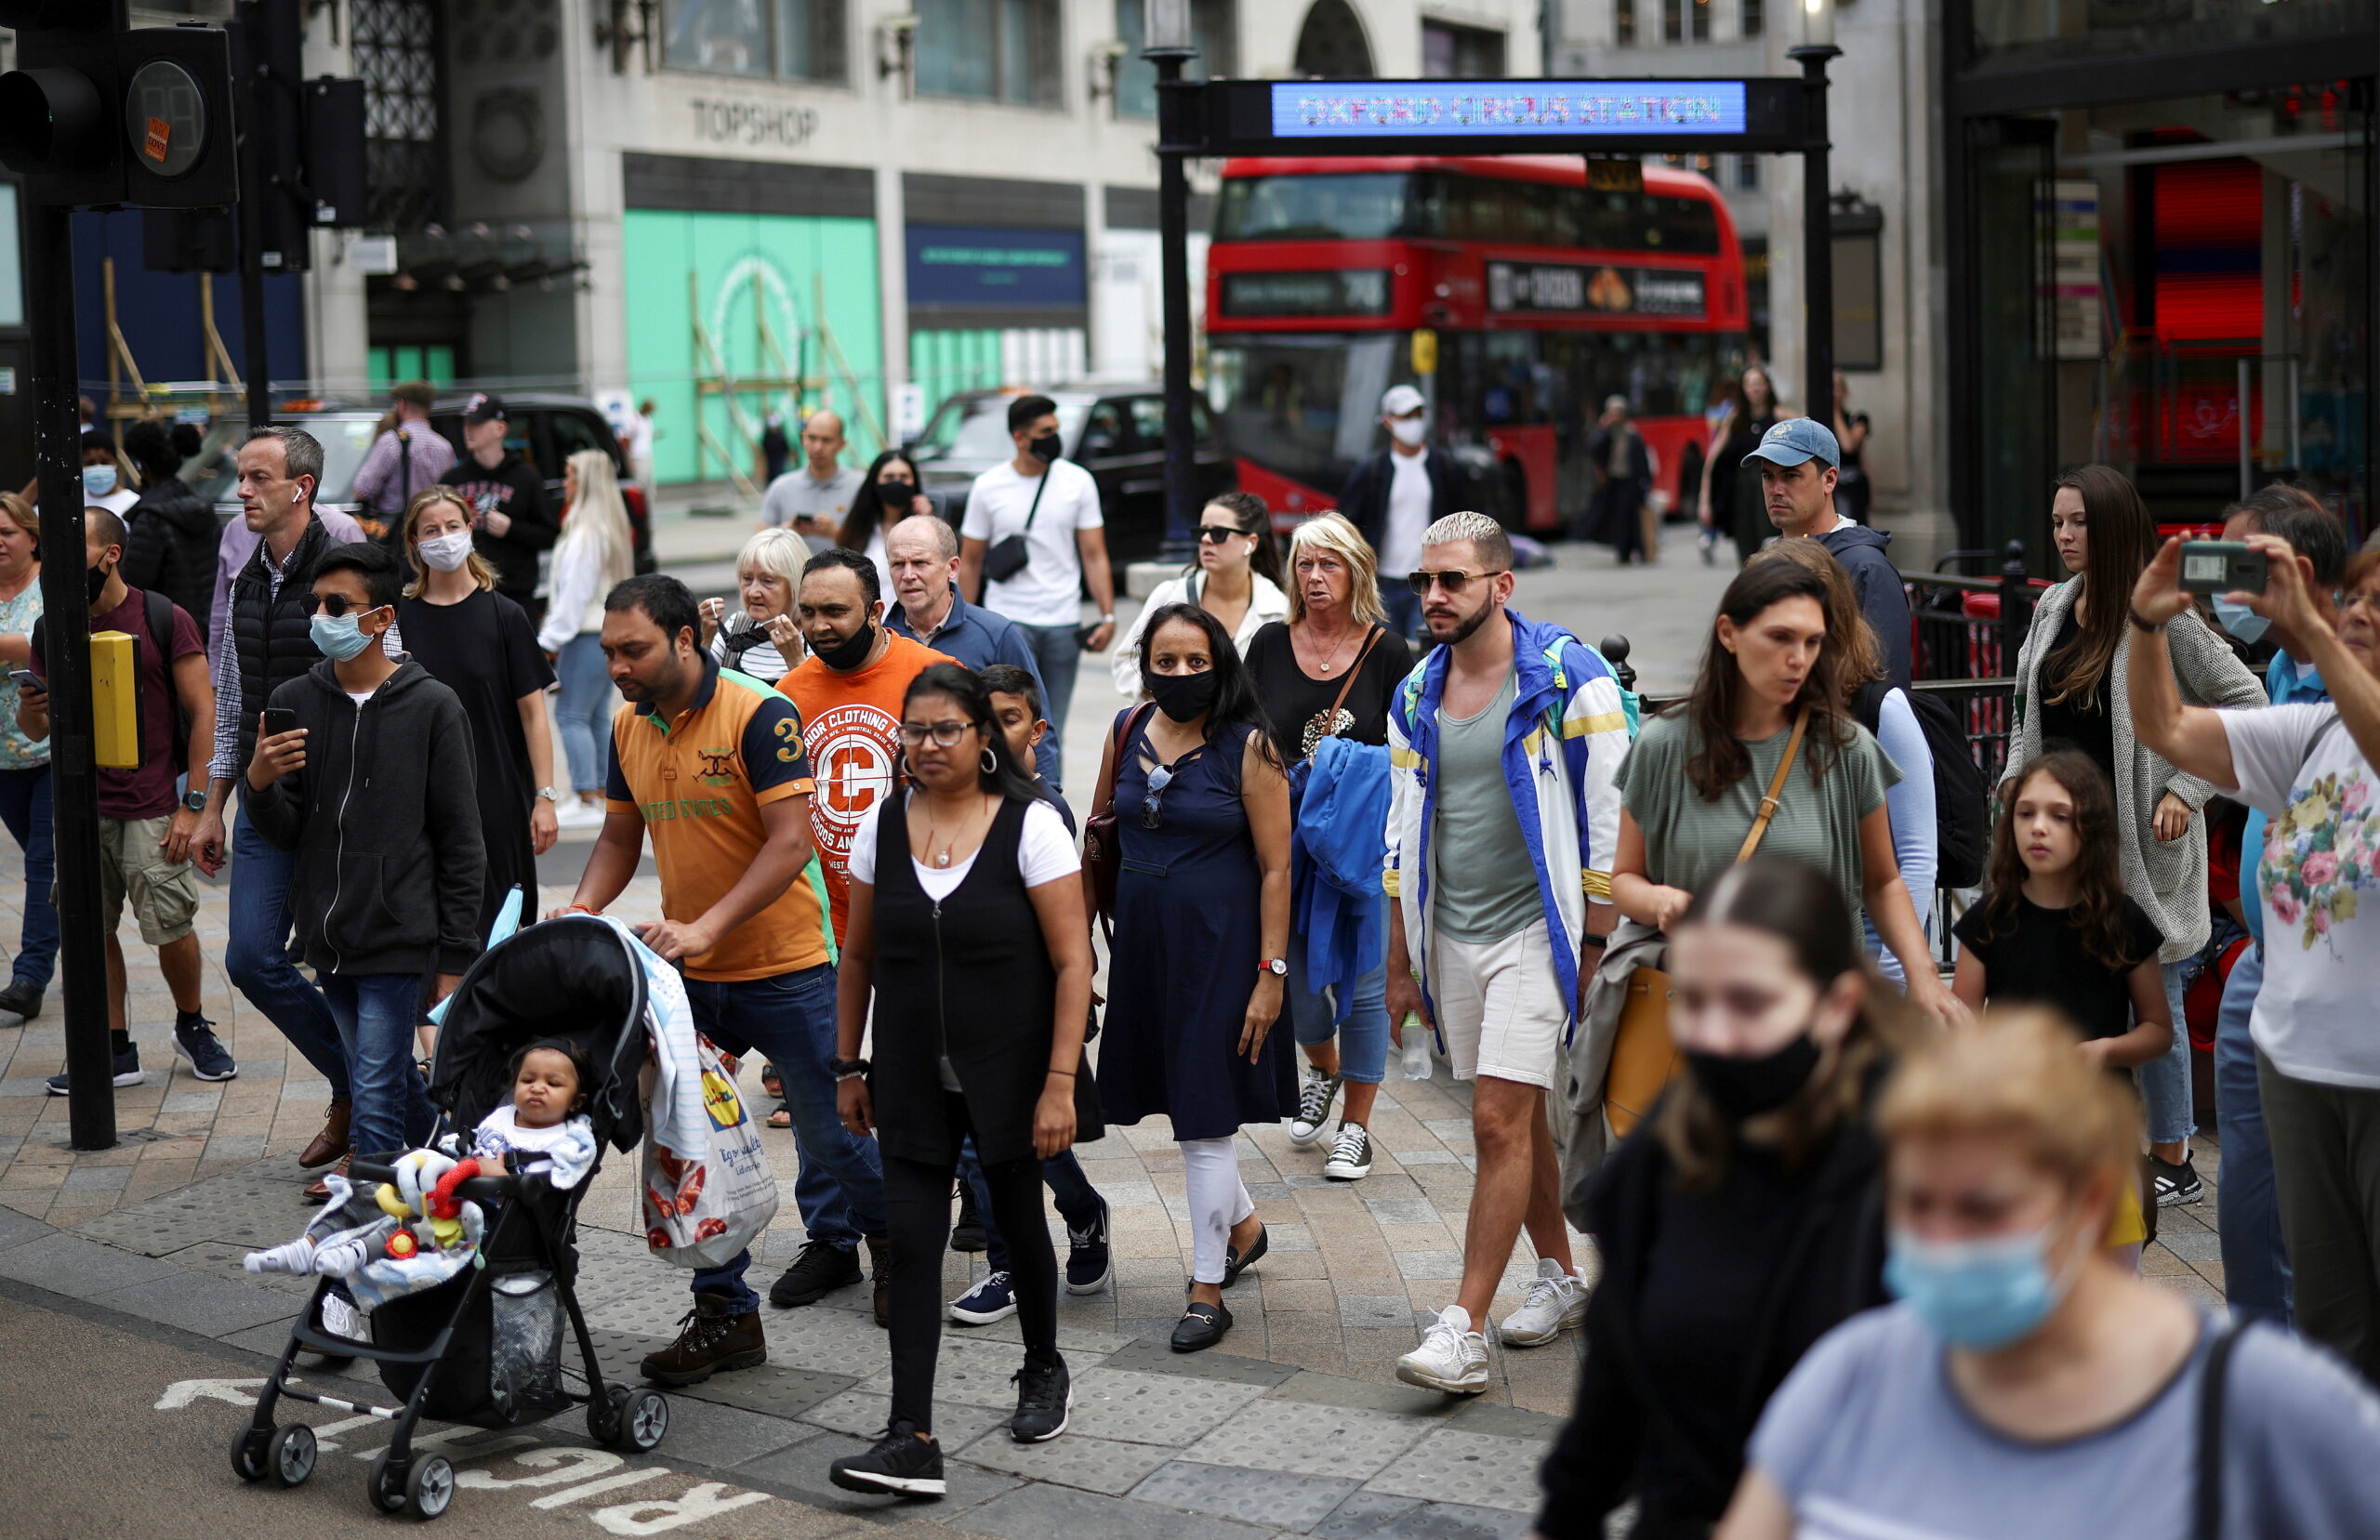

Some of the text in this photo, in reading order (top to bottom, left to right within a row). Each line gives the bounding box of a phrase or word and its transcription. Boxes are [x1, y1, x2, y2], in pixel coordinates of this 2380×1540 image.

[691, 99, 819, 148] TOPSHOP
[1300, 95, 1722, 125] OXFORD CIRCUS STATION
[148, 136, 166, 151] LOVE
[774, 718, 804, 762] 3
[804, 721, 827, 757] RIOR
[828, 709, 889, 731] CLOTHING
[679, 797, 733, 819] STATES
[811, 810, 835, 847] GOODS
[836, 836, 854, 849] AN
[828, 860, 845, 869] WEST
